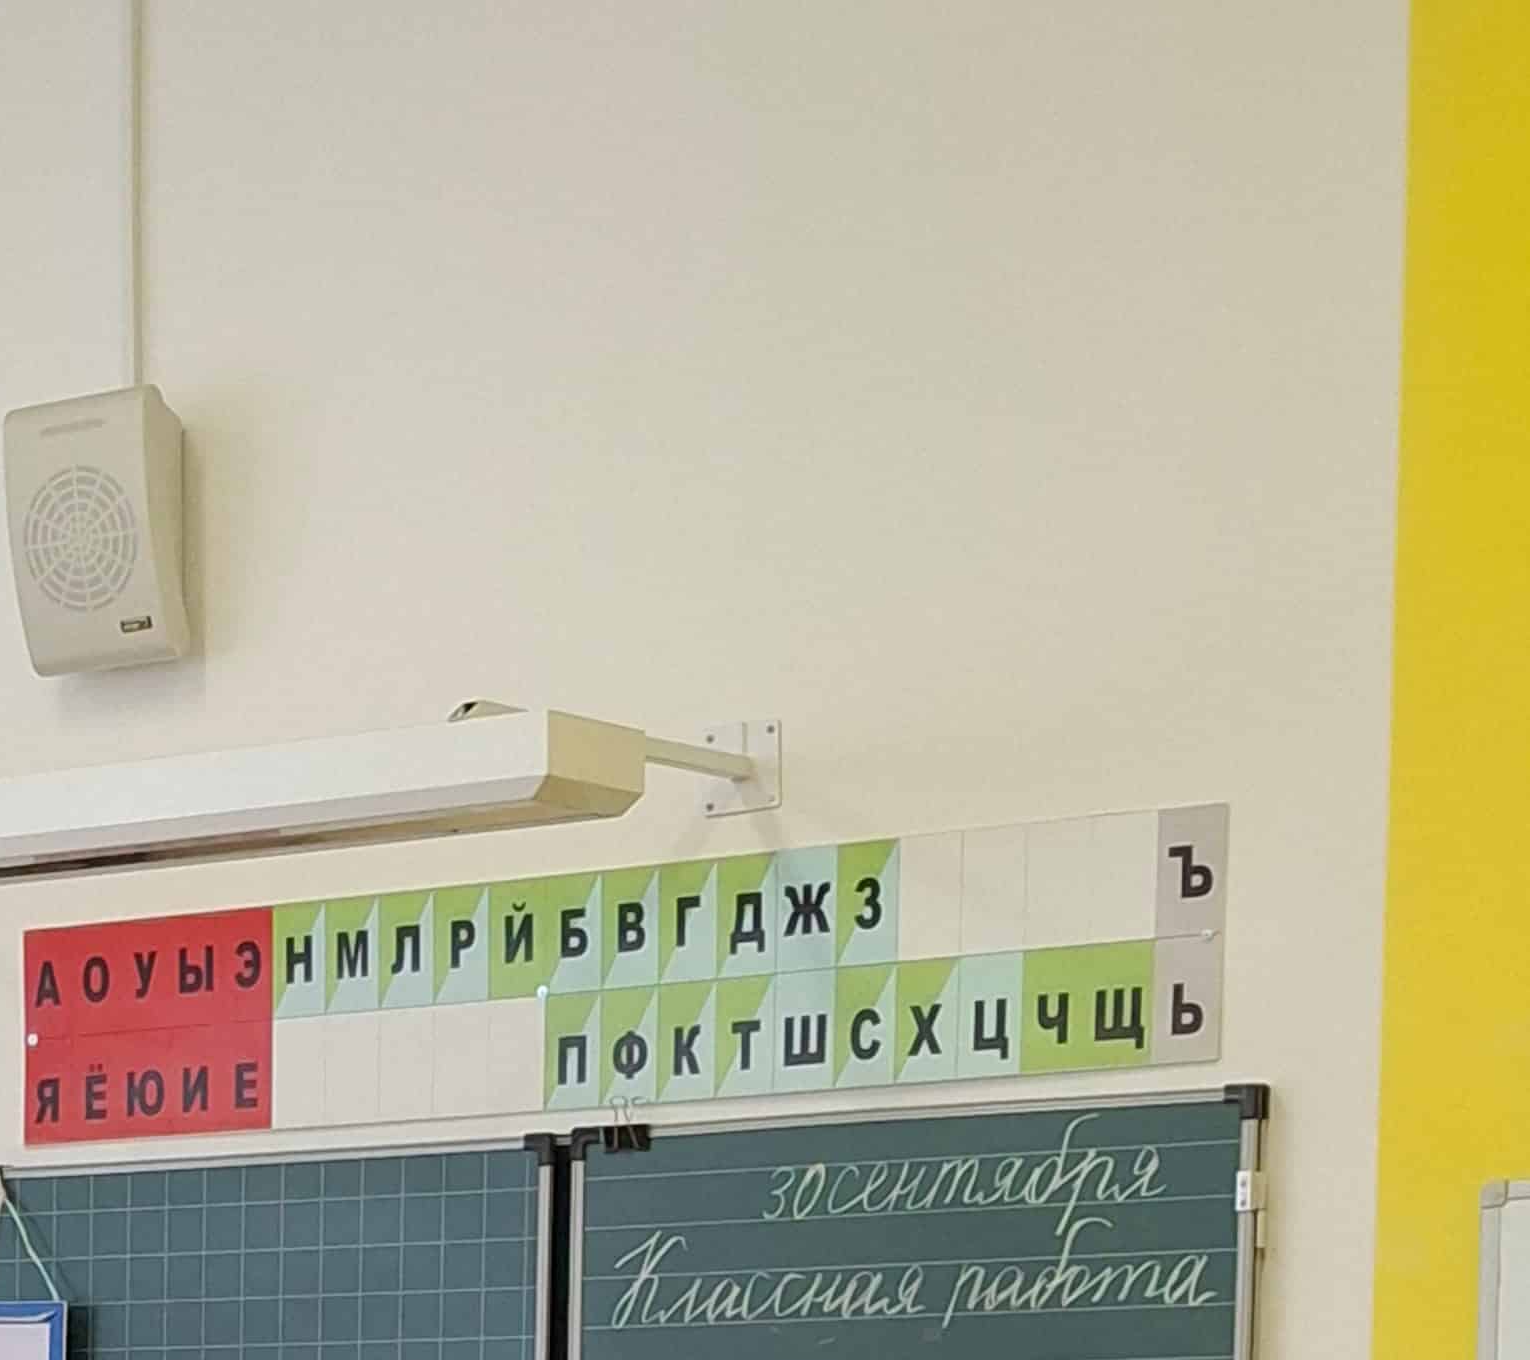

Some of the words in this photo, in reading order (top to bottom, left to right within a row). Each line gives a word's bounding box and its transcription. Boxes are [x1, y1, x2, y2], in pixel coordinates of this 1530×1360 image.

[35, 961, 61, 1008] А
[82, 956, 110, 1004] О
[134, 951, 156, 998] У
[178, 946, 214, 994] Ы
[234, 941, 262, 988] Э
[286, 936, 312, 984] Н
[336, 930, 369, 978] М
[391, 926, 419, 974] Л
[451, 921, 475, 968] Р
[504, 902, 533, 964] Й
[561, 908, 588, 958] Б
[618, 903, 645, 953] В
[676, 897, 700, 948] Г
[730, 892, 765, 953] Д
[784, 883, 831, 937] Ж
[855, 877, 881, 930] З
[1170, 845, 1213, 899] Ъ
[36, 1077, 60, 1124] Я
[84, 1064, 106, 1119] Ё
[126, 1070, 164, 1116] Ю
[182, 1066, 208, 1112] И
[235, 1062, 258, 1108] Е
[558, 1036, 586, 1085] П
[613, 1031, 648, 1079] Ф
[673, 1025, 700, 1076] К
[732, 1020, 760, 1070] Т
[784, 1015, 827, 1066] Ш
[851, 1009, 881, 1060] С
[909, 1004, 941, 1056] Х
[975, 999, 1009, 1058] Ц
[1038, 994, 1068, 1044] Ч
[1095, 987, 1144, 1049] Щ
[1172, 983, 1203, 1036] Ь
[614, 1230, 926, 1328] Классная
[942, 1218, 1217, 1328] работа
